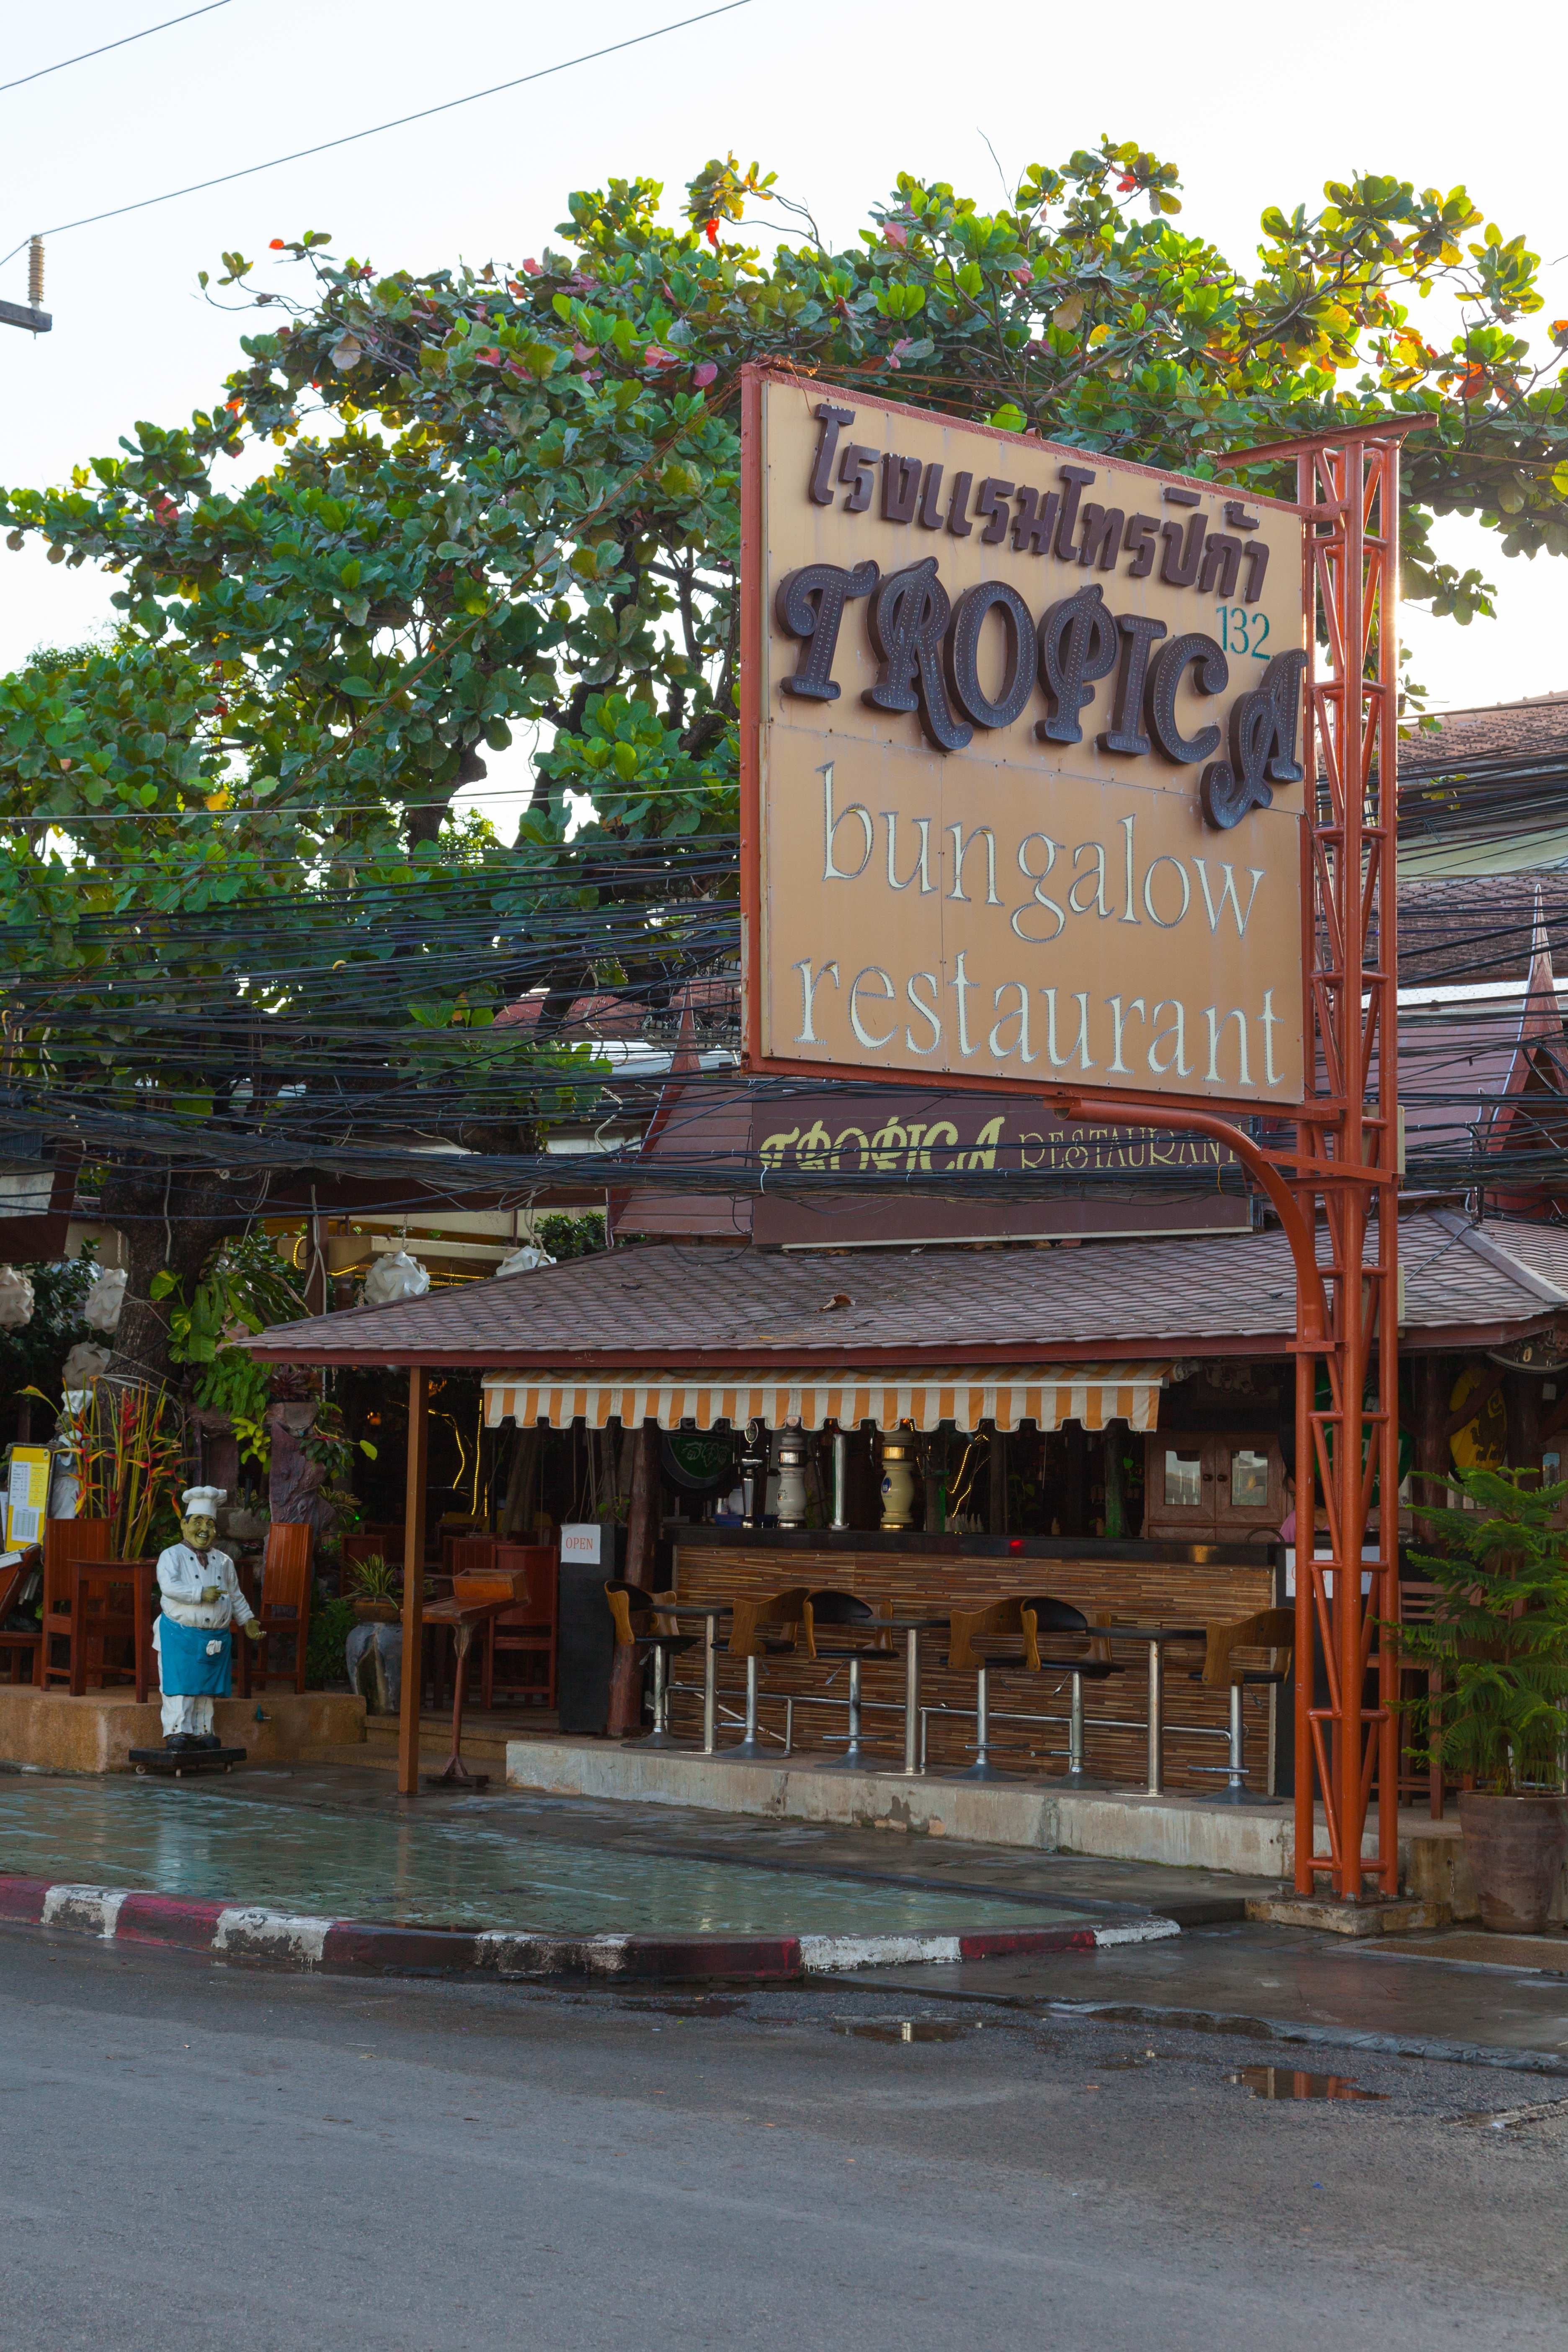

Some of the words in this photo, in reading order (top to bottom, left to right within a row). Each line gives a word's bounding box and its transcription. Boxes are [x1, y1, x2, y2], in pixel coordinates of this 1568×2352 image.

[1216, 606, 1270, 660] 132
[776, 556, 1309, 830] TROPICA
[815, 761, 1265, 943] bungalow
[792, 950, 1284, 1087] restaurant
[760, 1115, 1005, 1172] TROPICA
[566, 1537, 593, 1549] OPEN
